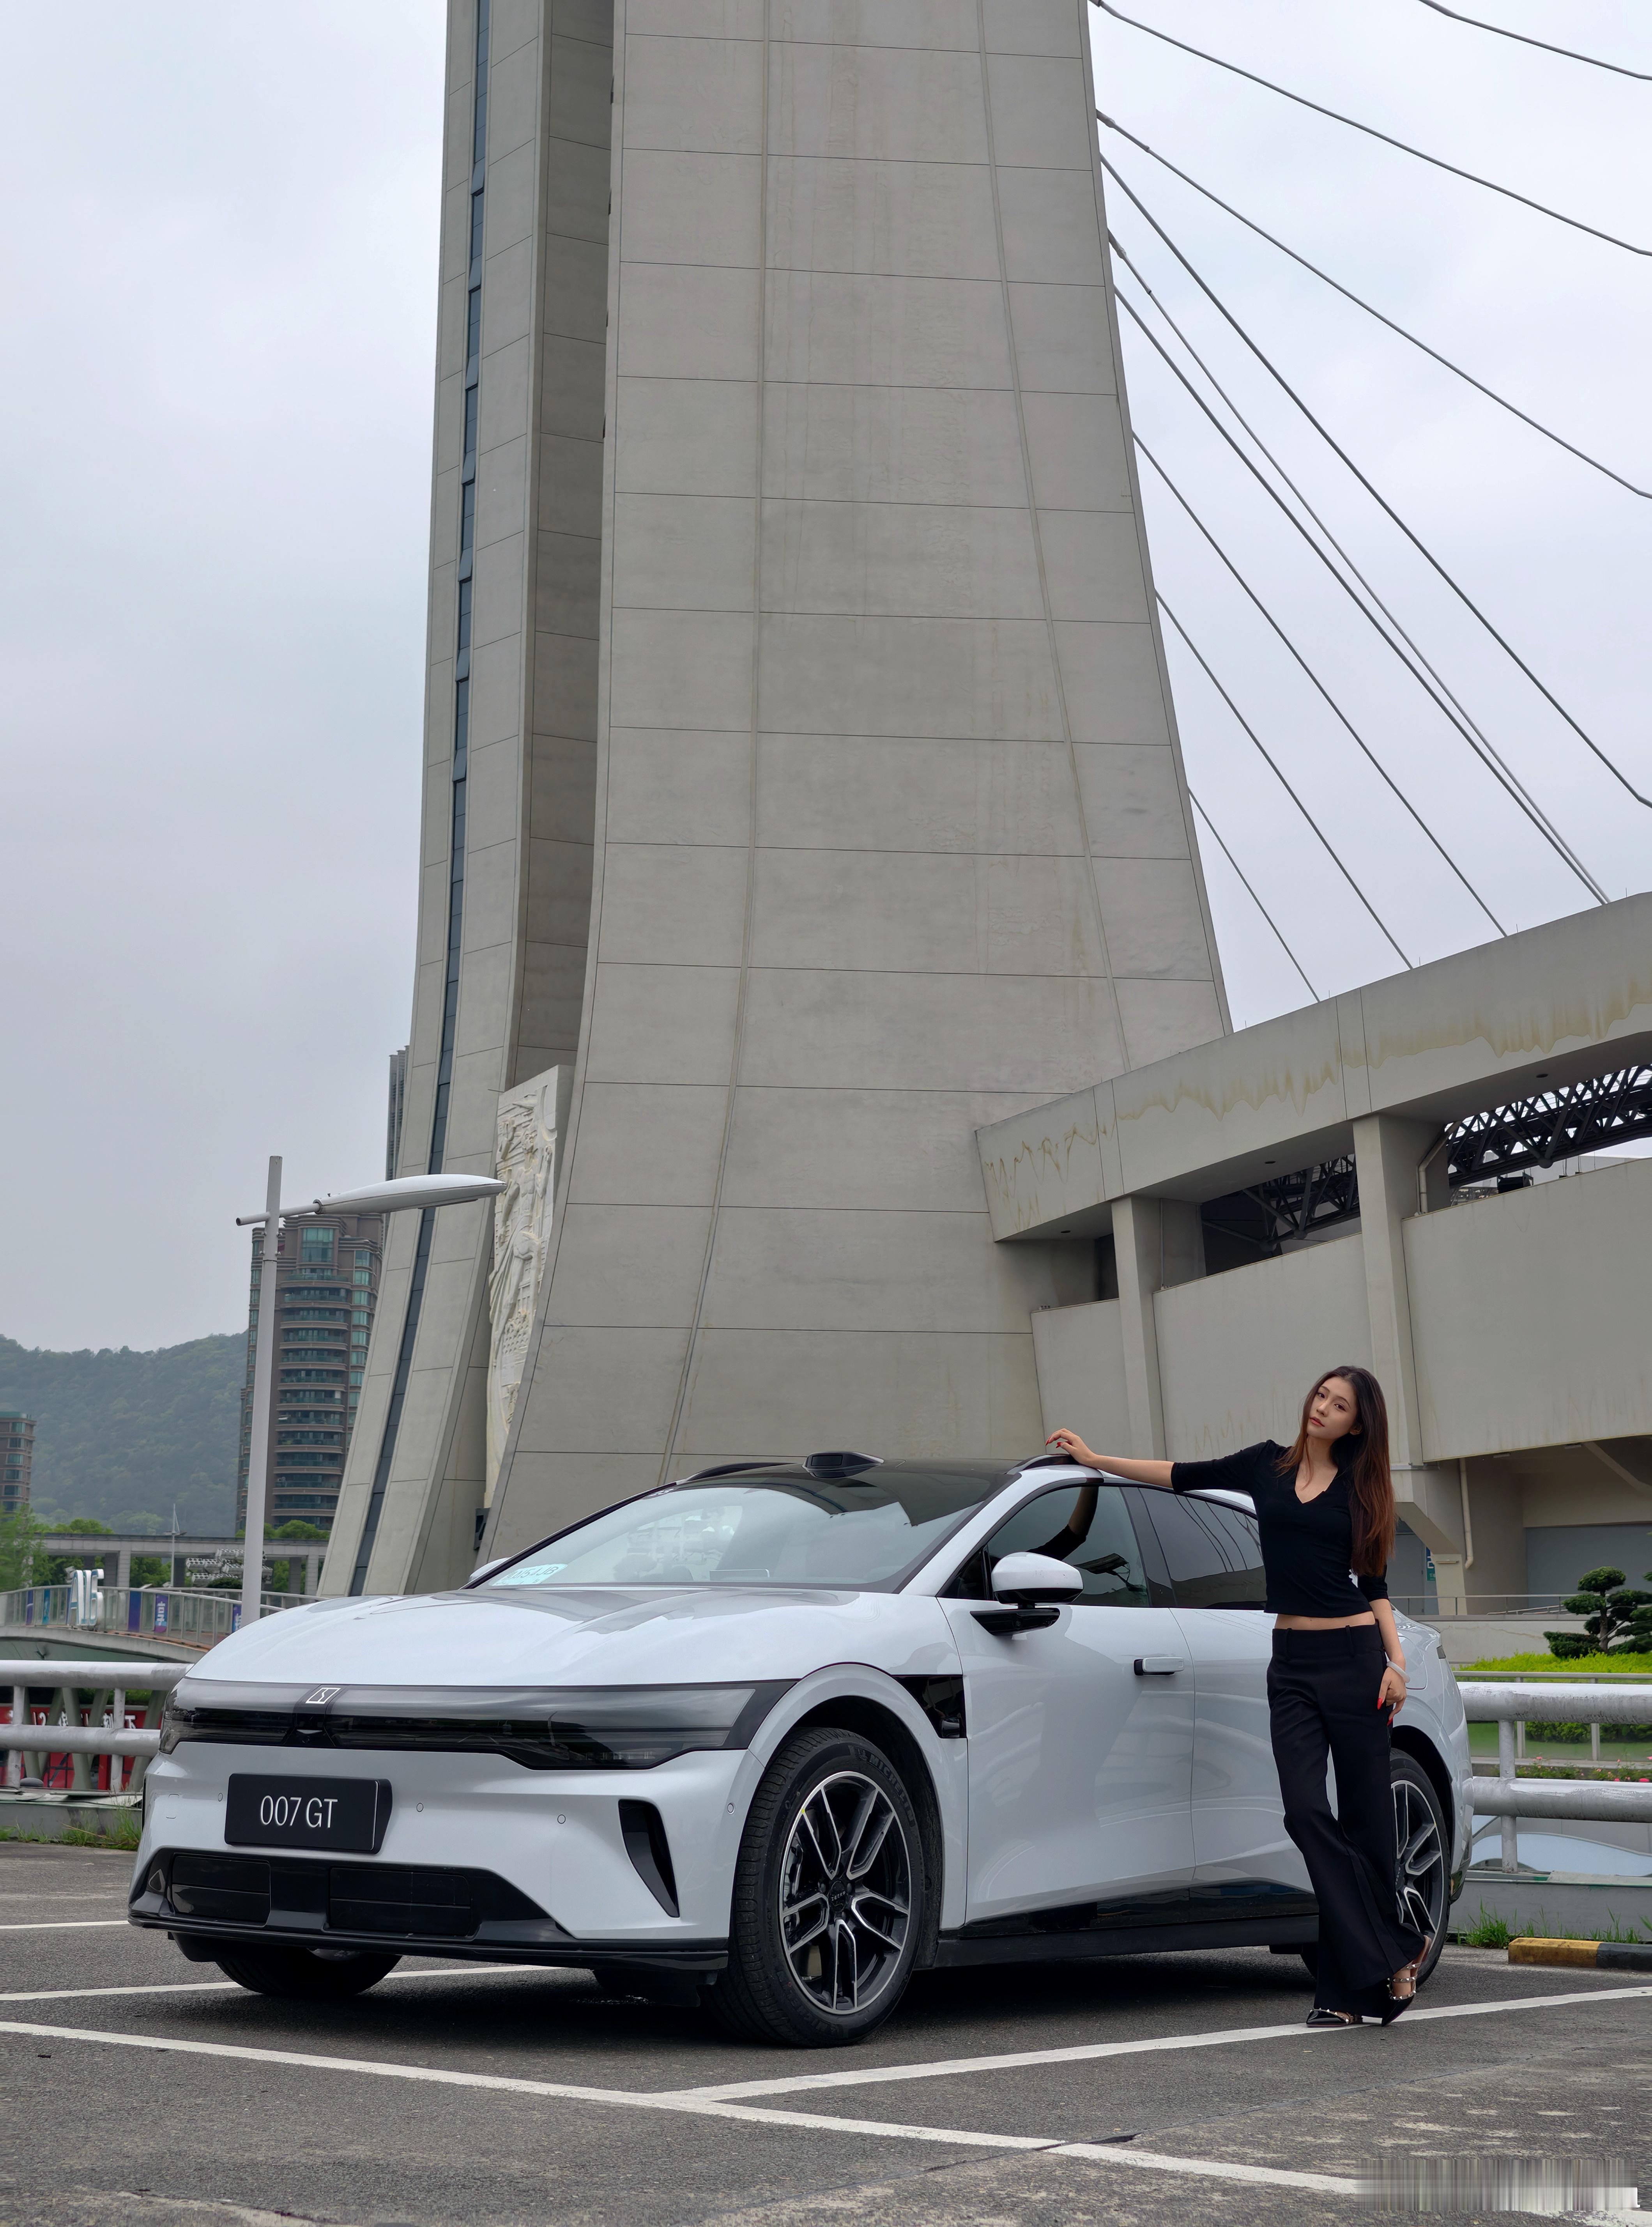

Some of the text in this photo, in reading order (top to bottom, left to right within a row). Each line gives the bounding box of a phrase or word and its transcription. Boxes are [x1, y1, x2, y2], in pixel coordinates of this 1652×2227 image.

[869, 1754, 914, 1822] MICHELIN
[260, 1795, 338, 1828] 007 GT
[831, 1891, 846, 1901] ZEEKR
